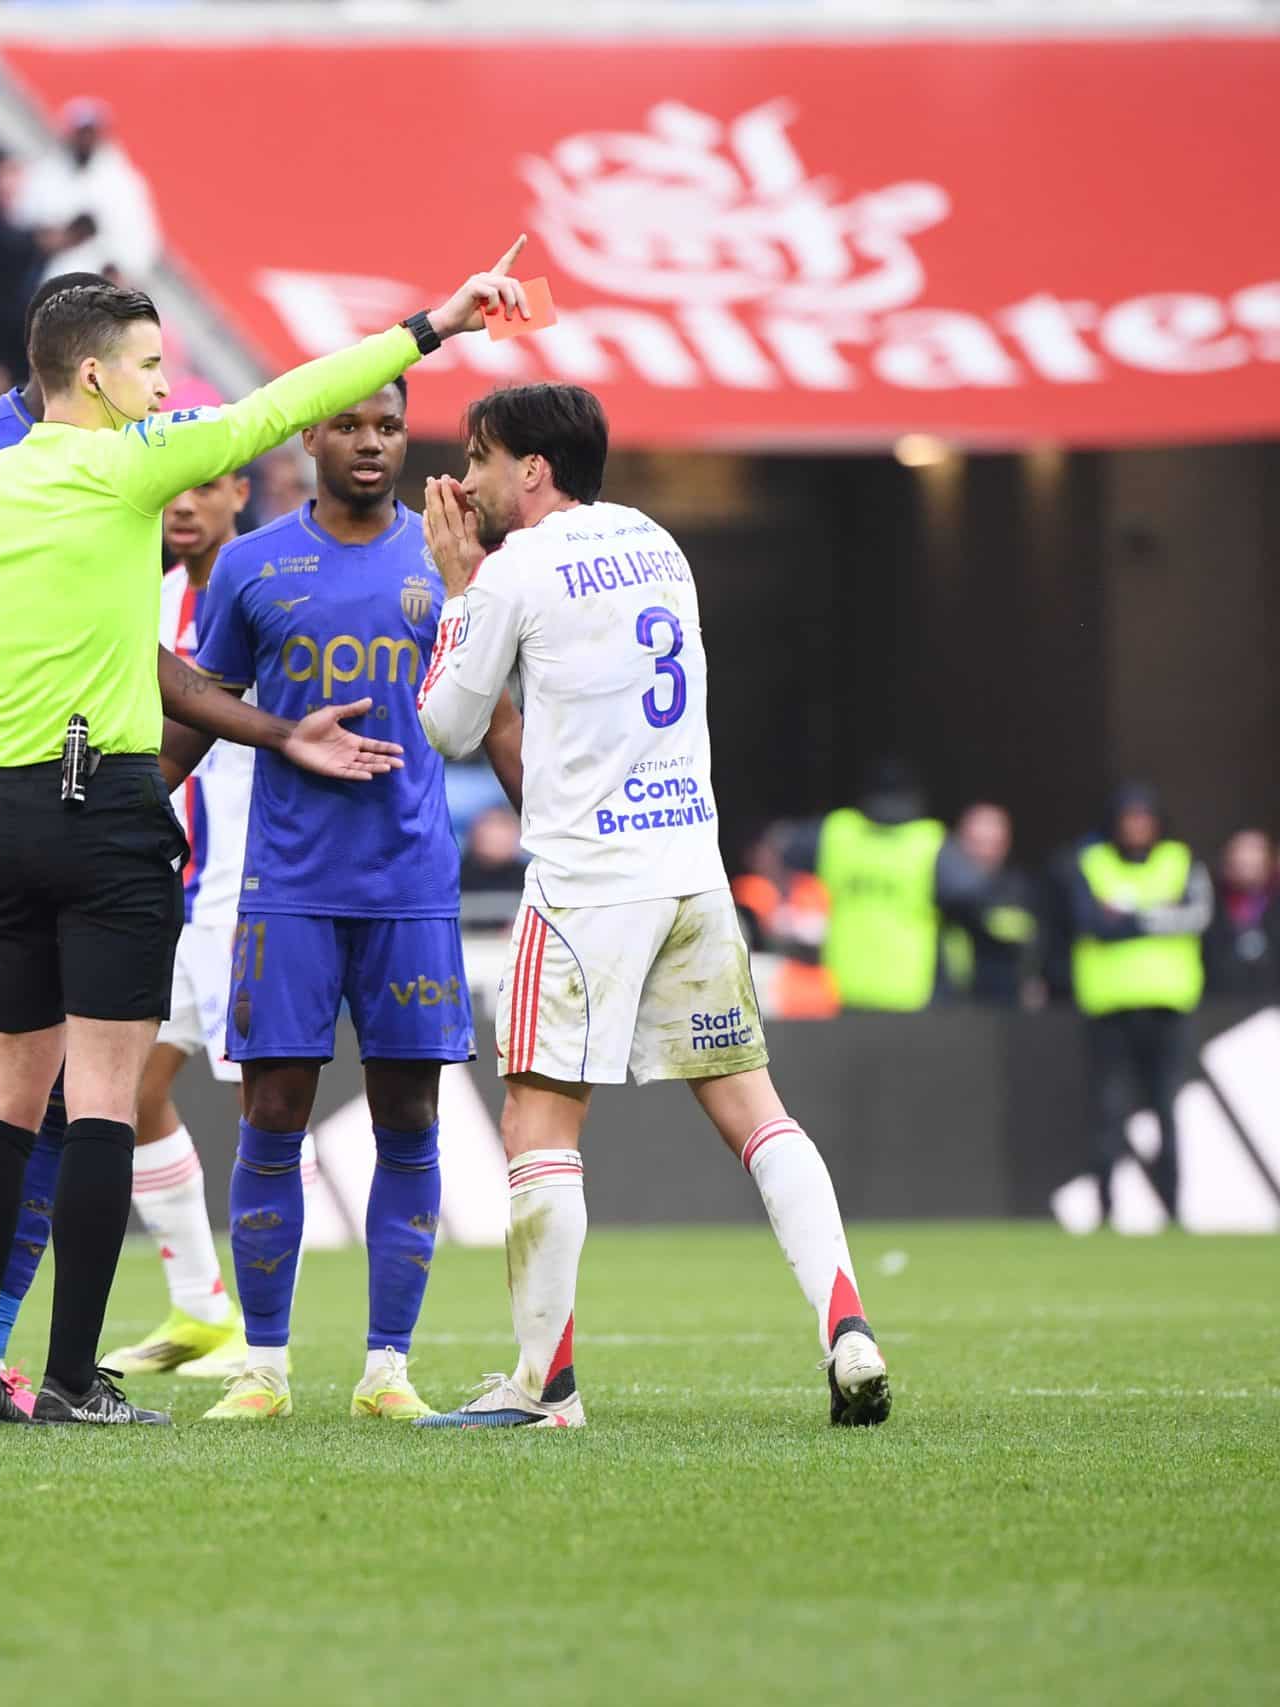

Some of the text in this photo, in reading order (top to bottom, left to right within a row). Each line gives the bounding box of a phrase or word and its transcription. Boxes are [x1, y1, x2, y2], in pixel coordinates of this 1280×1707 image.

[282, 634, 420, 699] apm
[636, 606, 687, 729] 3
[624, 777, 699, 804] Congo
[691, 1006, 741, 1032] Staff
